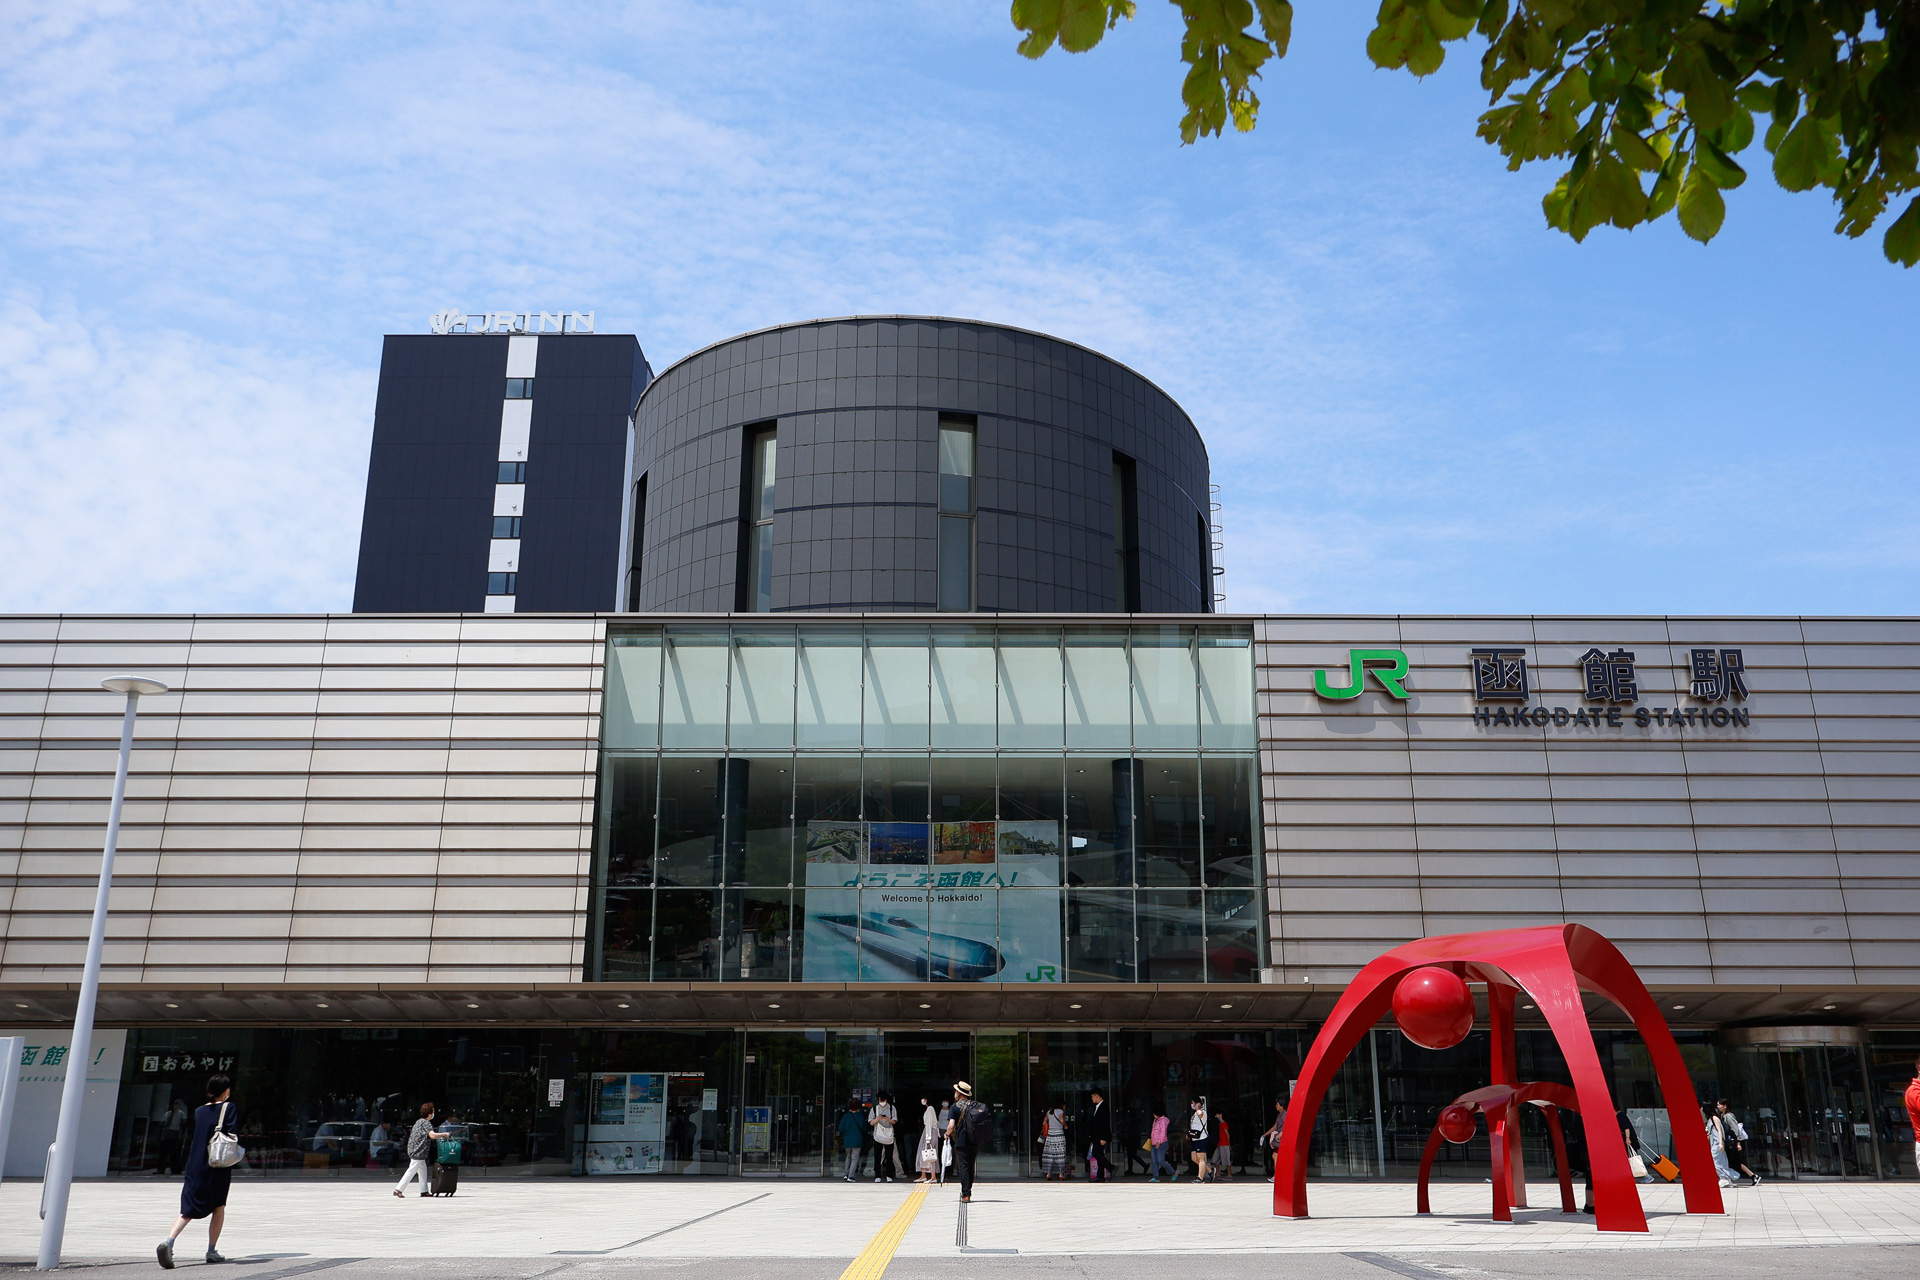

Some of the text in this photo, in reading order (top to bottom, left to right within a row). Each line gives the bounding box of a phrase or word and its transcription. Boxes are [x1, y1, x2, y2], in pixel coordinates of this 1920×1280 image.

[1314, 649, 1411, 700] JR
[1471, 648, 1750, 702] 函館駅
[1474, 706, 1751, 728] HAKODATE STATION
[881, 894, 922, 902] Welcome
[937, 893, 983, 902] Hokkaido!
[1026, 965, 1056, 982] JR
[163, 1056, 235, 1072] おみやげ
